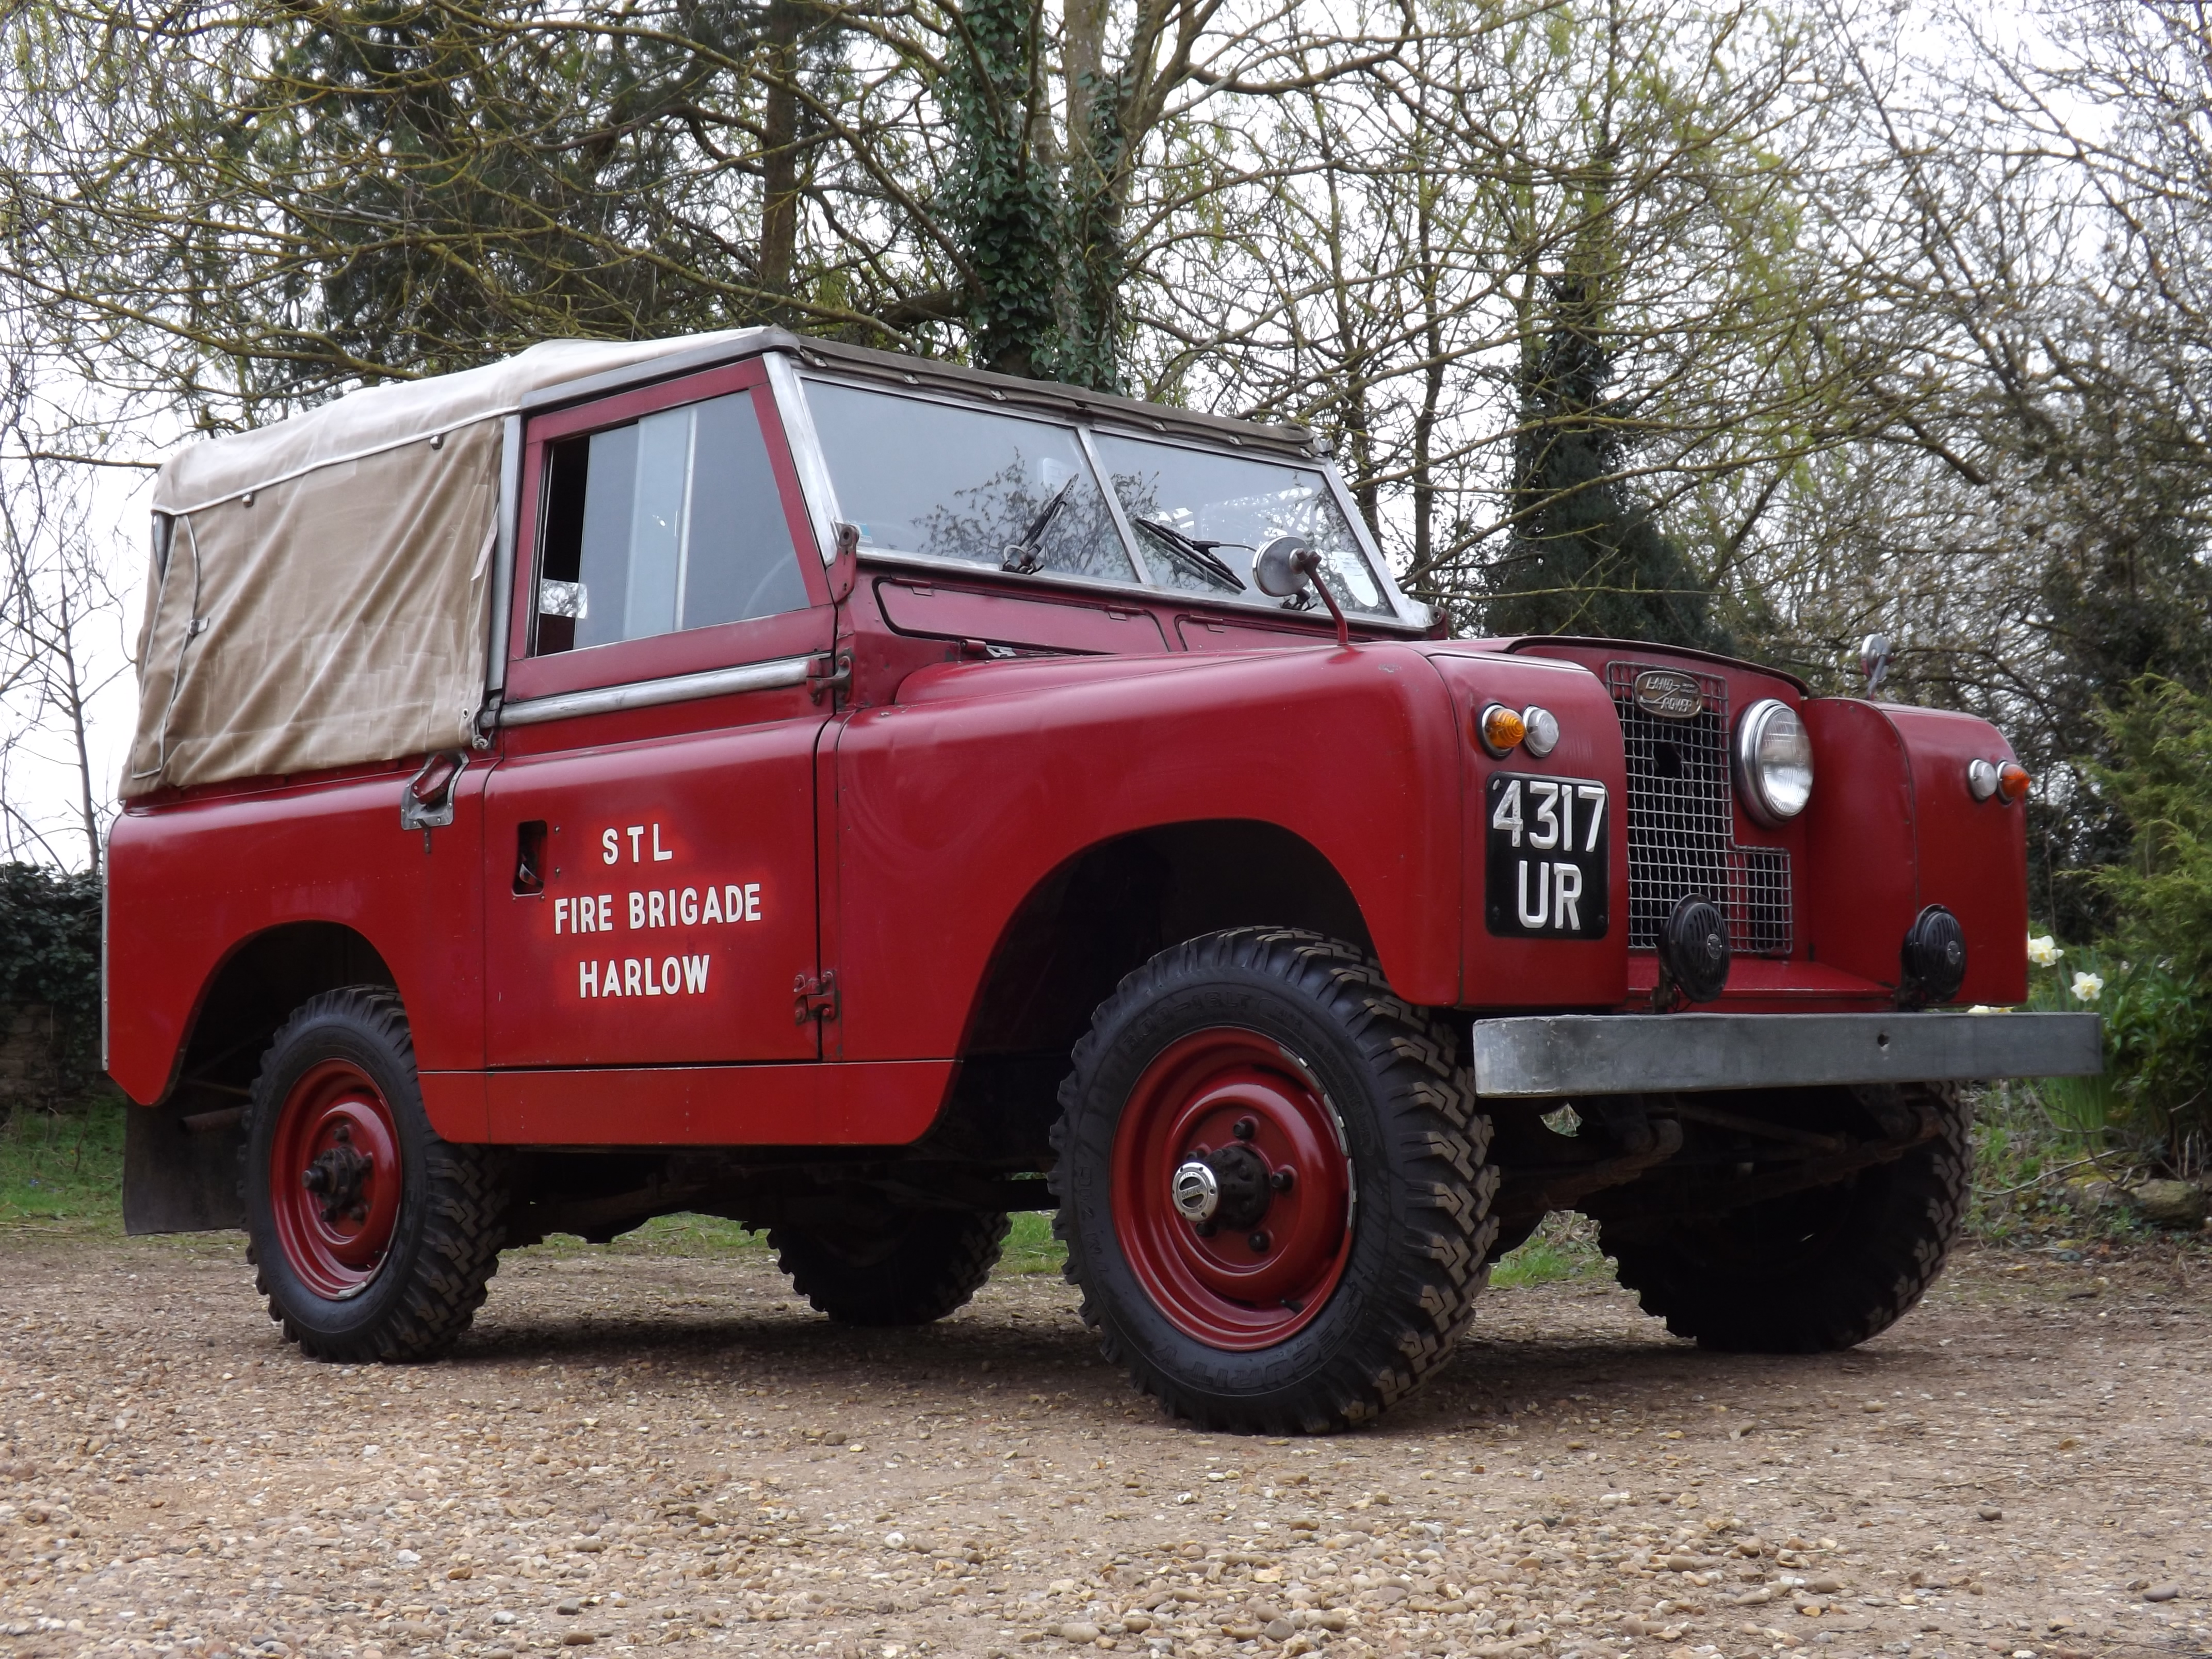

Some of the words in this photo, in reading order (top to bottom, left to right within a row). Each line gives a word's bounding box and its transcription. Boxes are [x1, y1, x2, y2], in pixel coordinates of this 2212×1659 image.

[1645, 676, 1673, 691] LAND
[1660, 697, 1692, 713] ROVER
[1492, 779, 1605, 852] 4317
[555, 894, 613, 934] FIRE
[629, 883, 761, 930] BRIGADE
[1518, 860, 1582, 930] UR
[579, 954, 710, 998] HARLOW
[1152, 1280, 1361, 1388] SECURITY
